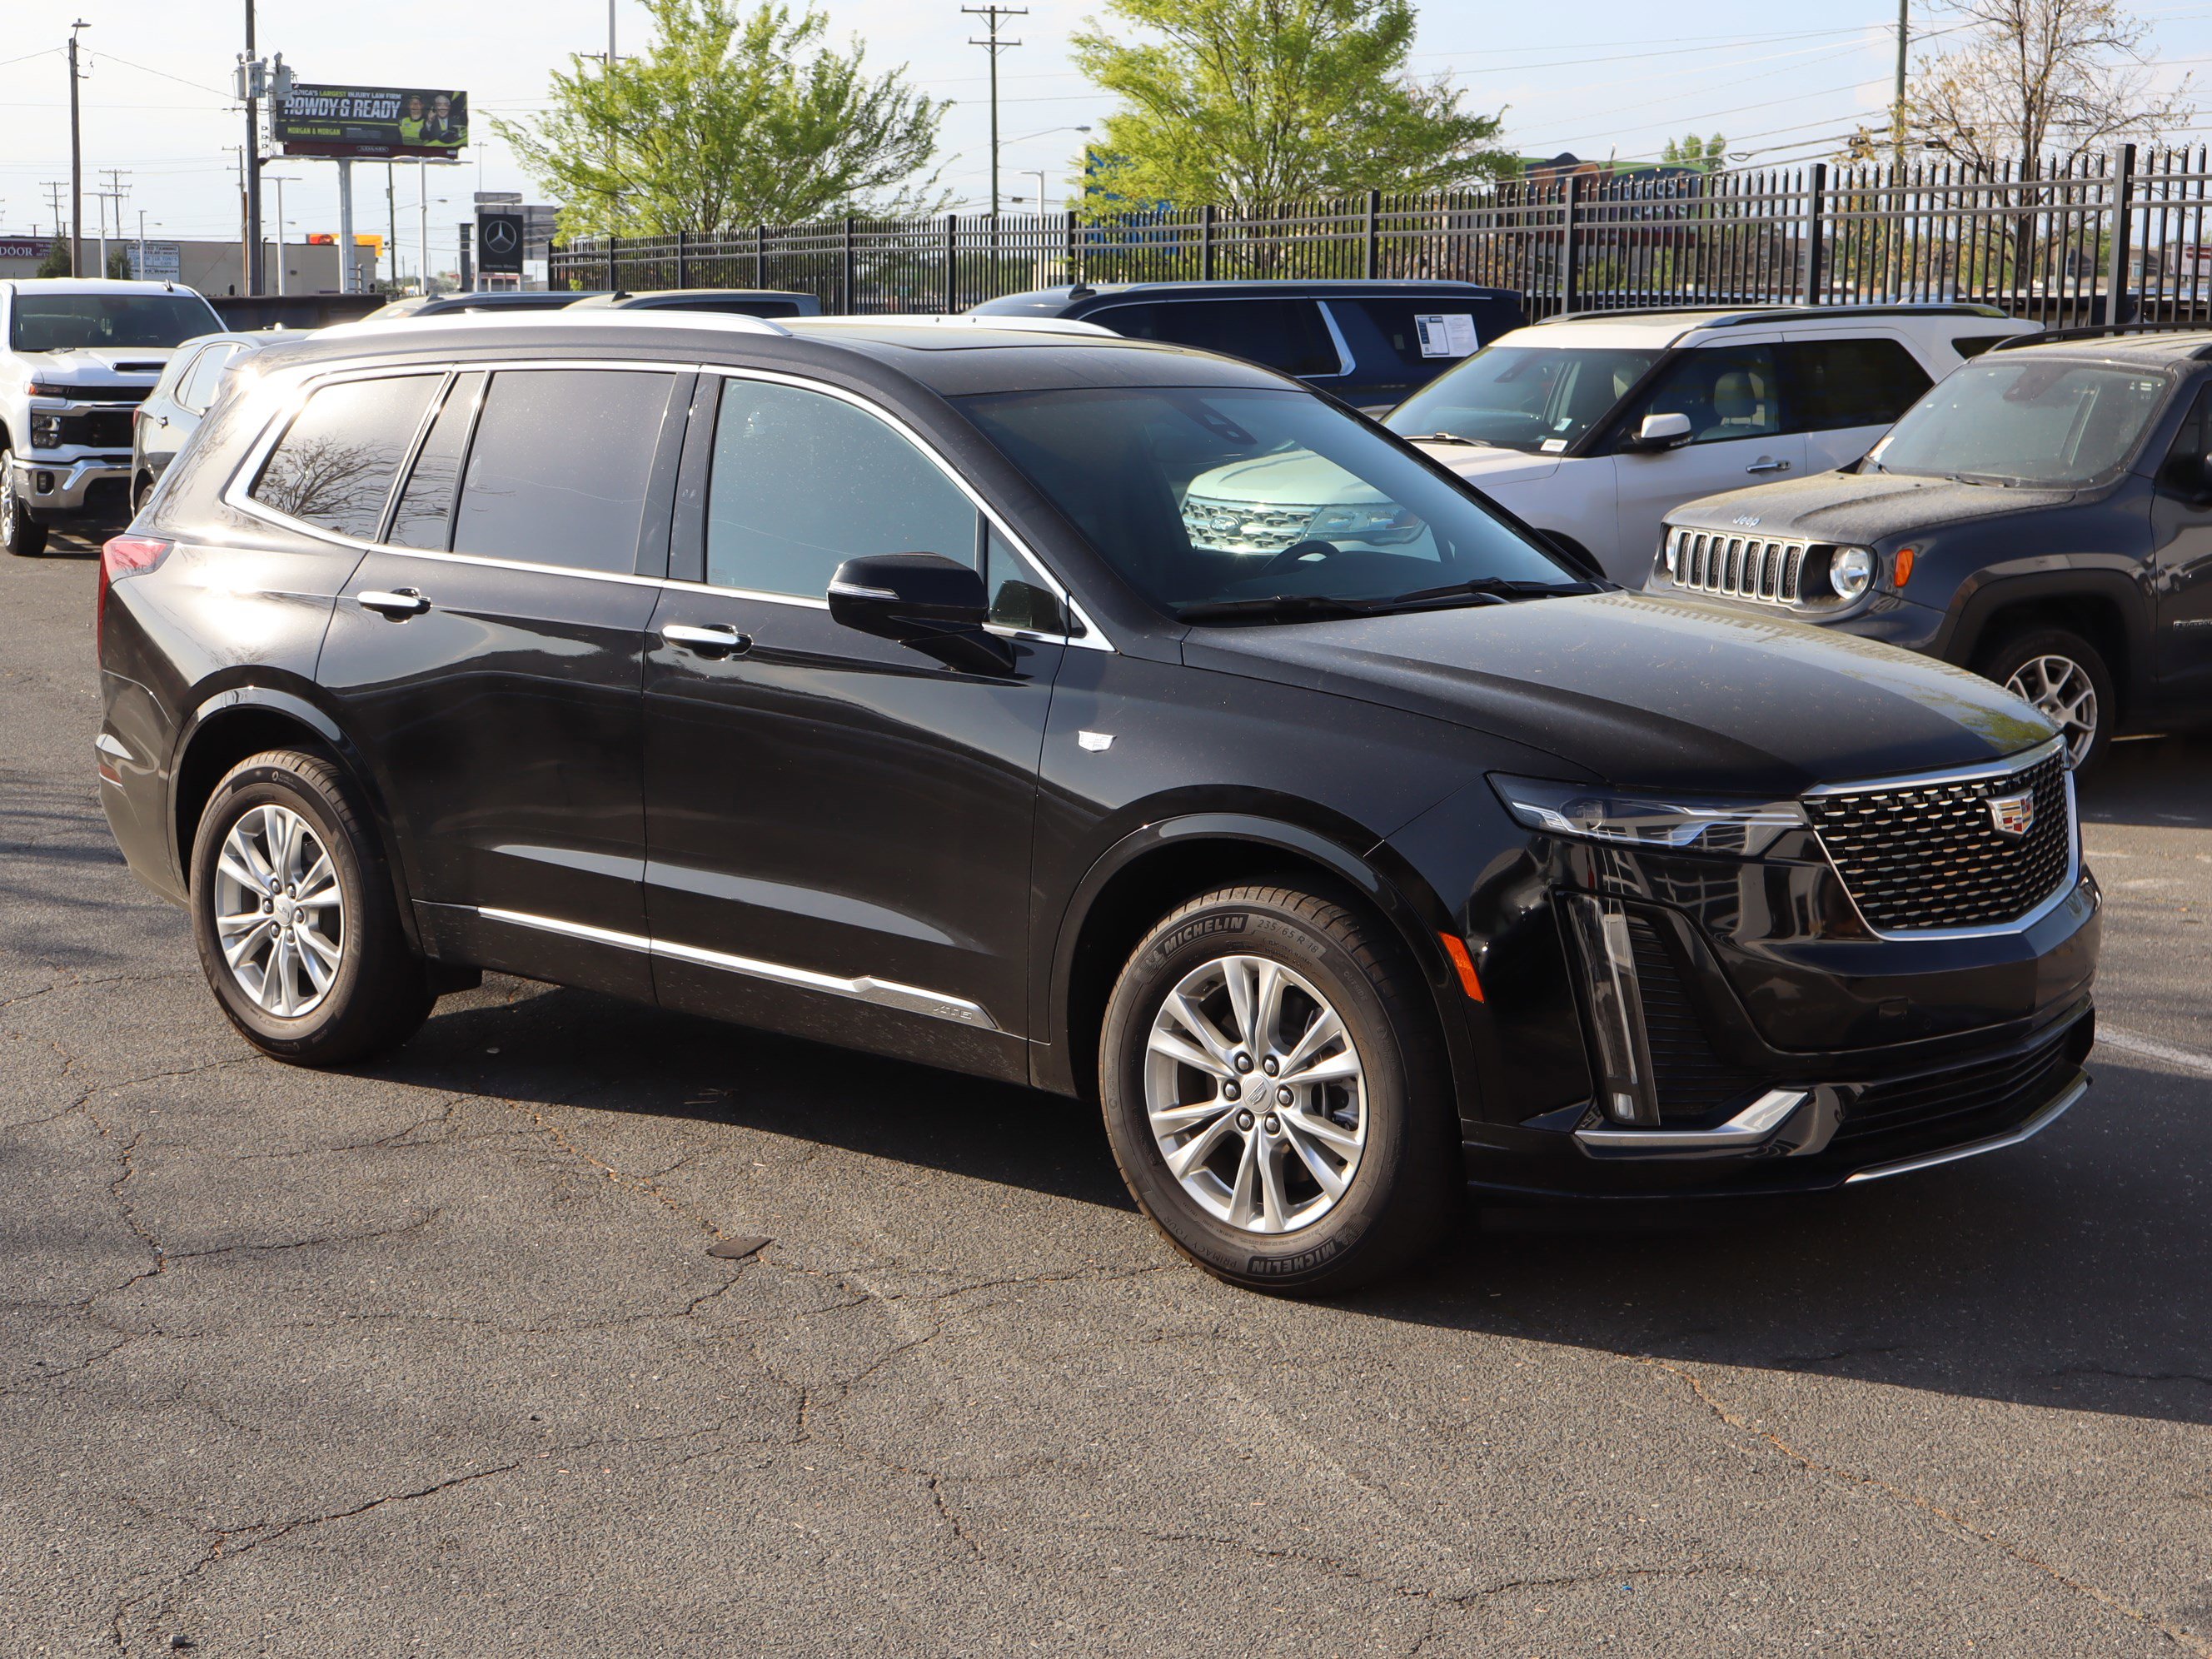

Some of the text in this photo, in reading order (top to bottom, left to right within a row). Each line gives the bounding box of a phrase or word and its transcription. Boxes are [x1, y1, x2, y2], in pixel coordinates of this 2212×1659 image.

[284, 97, 339, 116] ROWDY
[352, 100, 401, 119] READY
[287, 127, 311, 135] MORGAN
[317, 127, 341, 136] MORGAN
[0, 247, 32, 257] DOOR
[1732, 514, 1761, 528] Jeep
[1163, 916, 1243, 954] MICHELIN
[1257, 919, 1318, 954] 235/65 R 18
[1343, 970, 1368, 1001] OUTSIDE
[1163, 1216, 1188, 1241] TOUR
[1192, 1241, 1238, 1268] PRIMACY
[1251, 1240, 1337, 1273] MICHELIN
